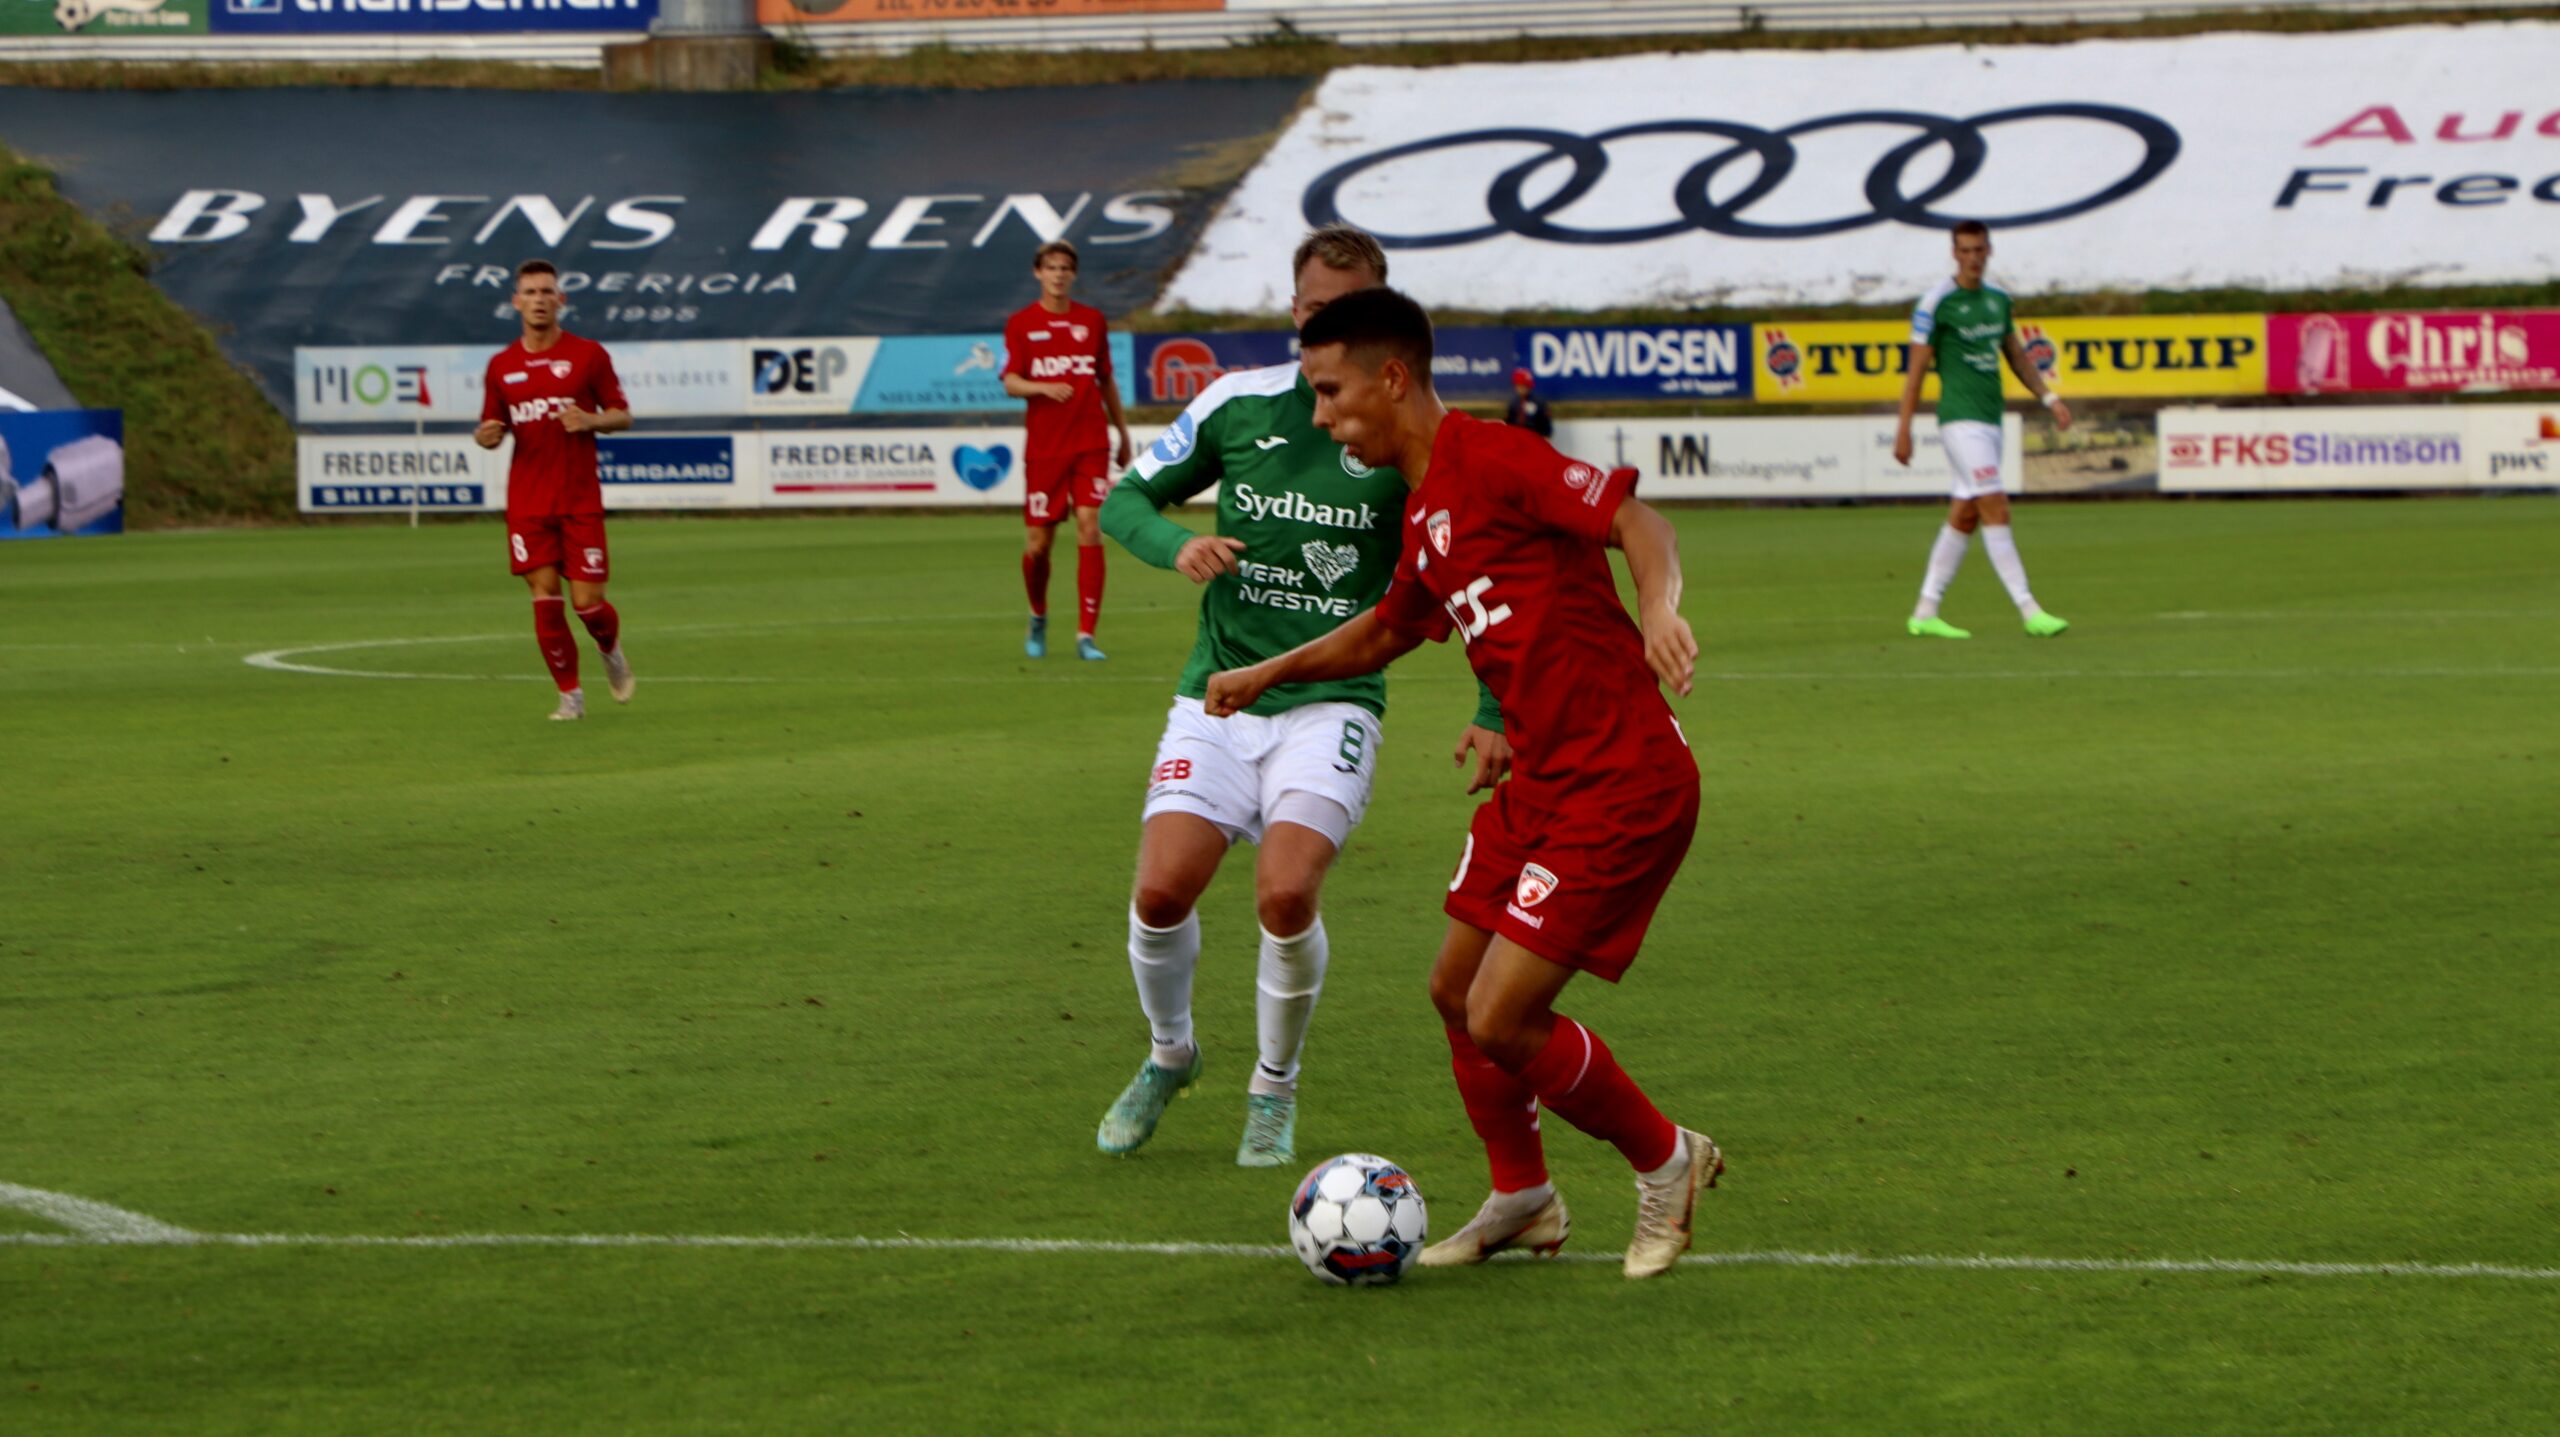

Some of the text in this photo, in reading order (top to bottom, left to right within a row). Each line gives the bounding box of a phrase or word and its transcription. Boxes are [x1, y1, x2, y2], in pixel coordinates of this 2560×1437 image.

[149, 190, 1178, 249] BYENS RENS
[436, 264, 797, 294] FRDERICIA
[1532, 330, 1737, 377] DAVIDSEN
[2065, 337, 2256, 371] TULIP
[2367, 313, 2529, 378] Chris
[754, 348, 847, 394] DEP
[323, 451, 470, 477] FREDERICIA
[771, 444, 936, 466] FREDERICIA
[1659, 434, 1709, 476] MN
[2490, 451, 2548, 476] pwc
[598, 464, 730, 480] TERGAARD
[322, 487, 473, 505] SHIPPING
[1029, 491, 1049, 518] 12
[1235, 483, 1378, 530] Sydbank
[511, 533, 529, 562] 8
